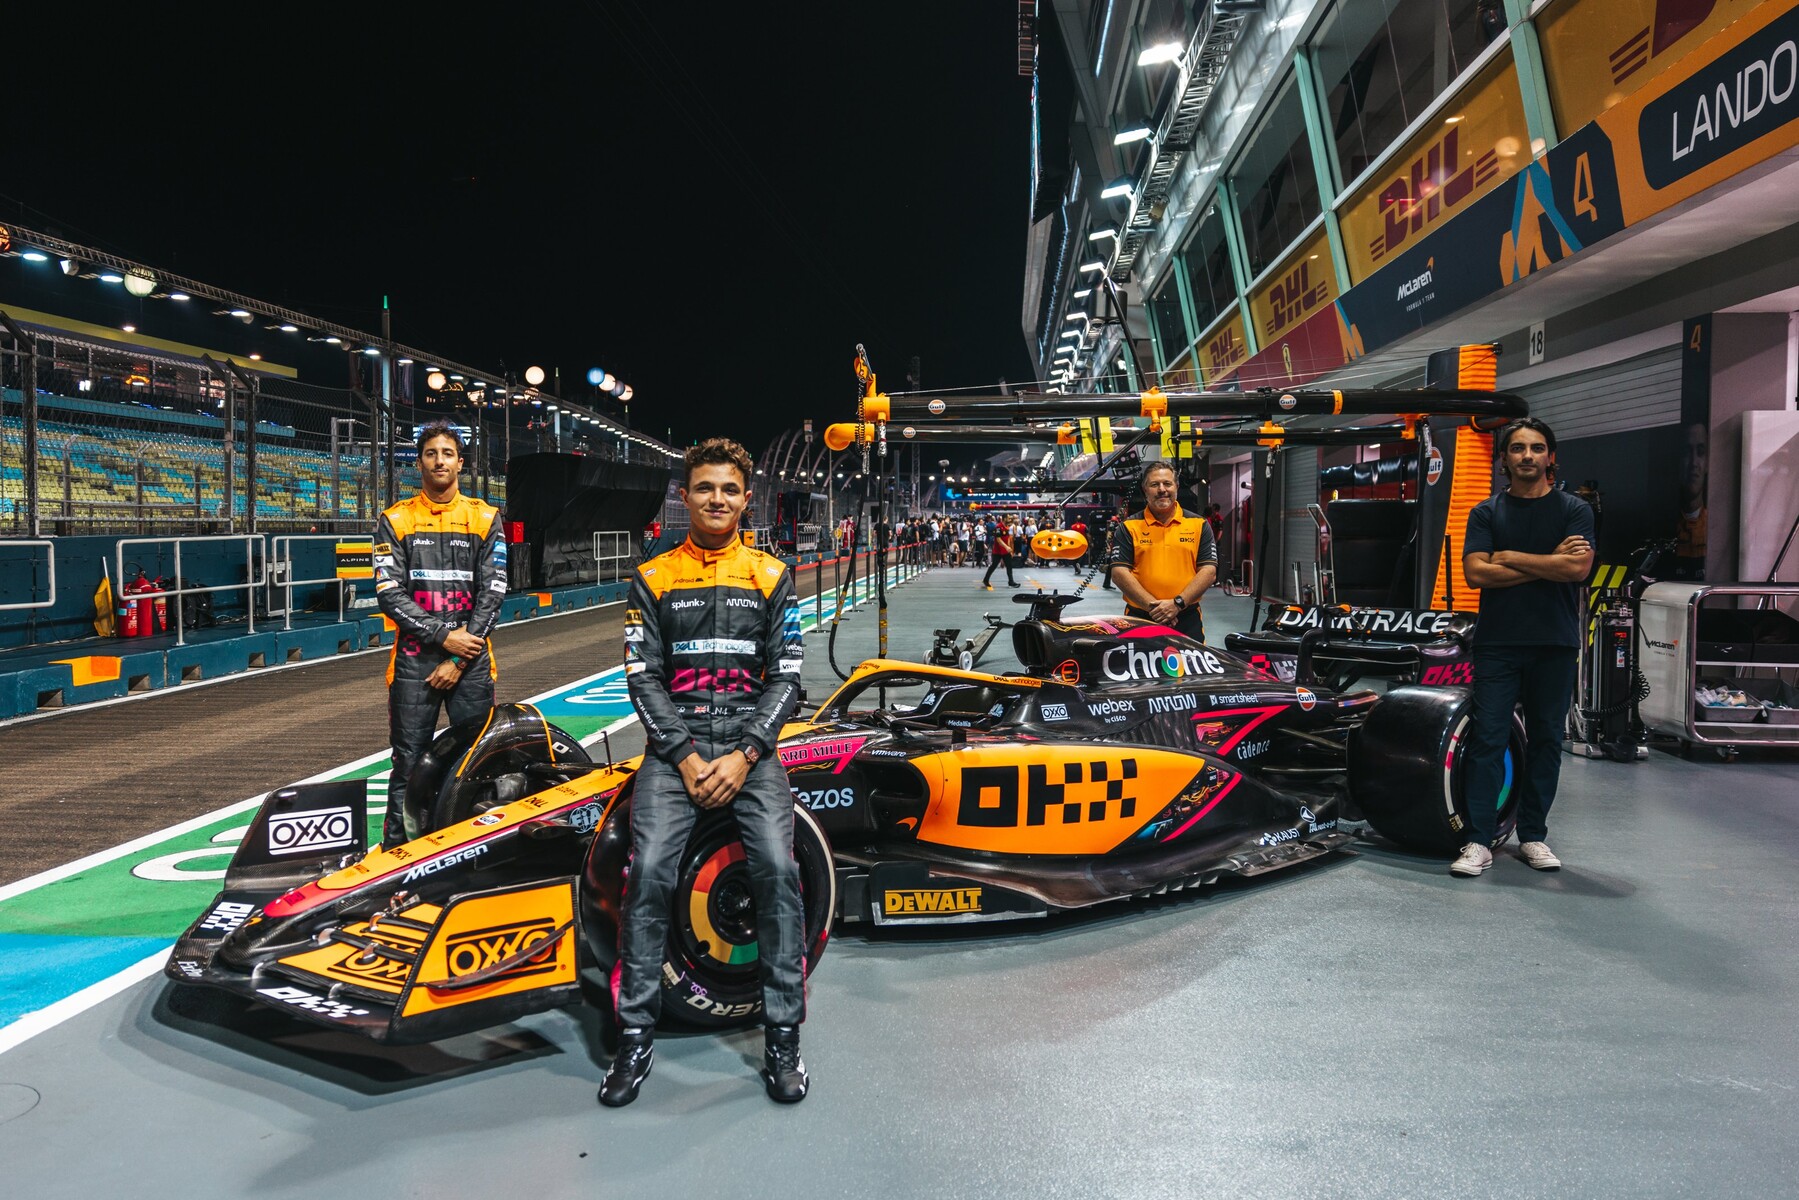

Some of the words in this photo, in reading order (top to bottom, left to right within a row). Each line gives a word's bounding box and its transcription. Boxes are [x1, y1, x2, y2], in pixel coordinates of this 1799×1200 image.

[1672, 39, 1797, 162] LANDO
[1378, 126, 1475, 253] DHL
[1573, 152, 1597, 222] 4
[1269, 261, 1318, 337] DHL
[1397, 270, 1433, 301] McLaren
[1209, 327, 1240, 378] DHL
[1531, 330, 1544, 356] 18
[1280, 398, 1297, 406] Gulf
[1101, 642, 1225, 682] Chrome
[1043, 706, 1068, 719] OXXO
[1087, 698, 1136, 717] webex
[1149, 692, 1197, 715] ARROW
[1219, 692, 1259, 704] smartsheet
[1298, 694, 1316, 702] Gulf
[947, 719, 972, 728] Medallia
[812, 742, 853, 757] MILLE
[871, 749, 907, 758] vmware
[957, 760, 1138, 828] OKX
[272, 815, 350, 847] OXXO
[1274, 827, 1301, 842] KAUST
[402, 844, 489, 885] McLaren
[449, 928, 556, 978] OXXO
[256, 986, 370, 1018] OKX
